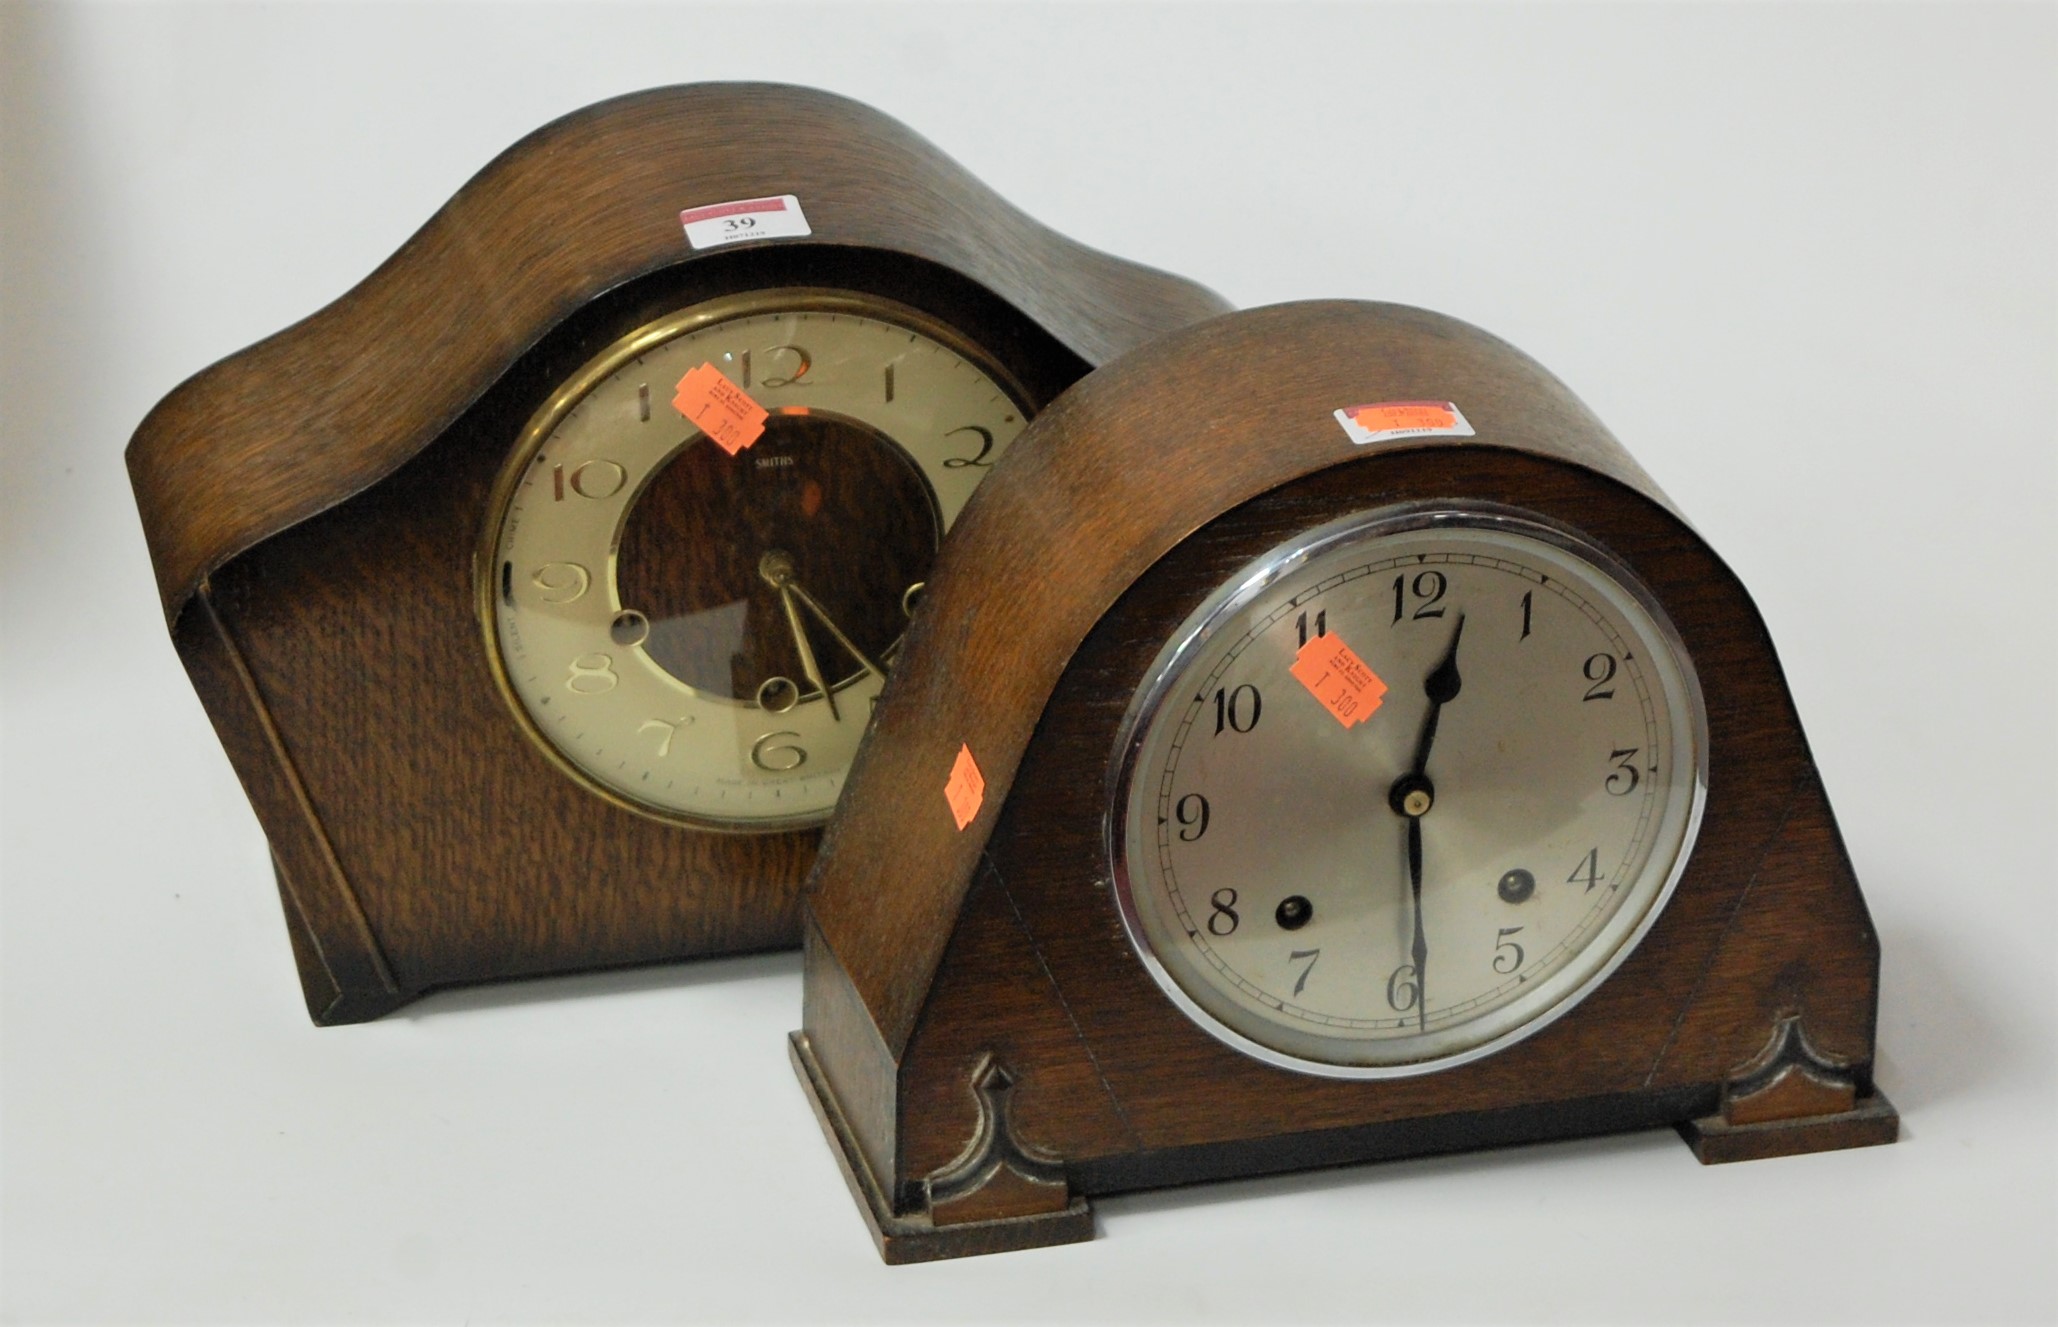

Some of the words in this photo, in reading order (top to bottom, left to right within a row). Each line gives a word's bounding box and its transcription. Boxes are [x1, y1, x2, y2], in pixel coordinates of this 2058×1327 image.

[723, 217, 756, 232] 39
[741, 345, 814, 388] 12
[884, 363, 895, 402] 1
[755, 456, 794, 469] SMITHS
[943, 426, 994, 468] 2
[553, 459, 628, 501] 10
[532, 562, 592, 603] 9
[1391, 571, 1448, 627] 12
[1520, 590, 1533, 641] 1
[565, 652, 618, 694] 8
[1583, 653, 1617, 701] 2
[1213, 684, 1262, 736] 10
[1329, 687, 1360, 718] 300
[637, 714, 695, 756] 7
[750, 731, 808, 772] 6
[1605, 748, 1639, 796] 3
[1176, 794, 1210, 841] 9
[1566, 848, 1605, 894] 4
[1206, 887, 1240, 936] 8
[1492, 927, 1525, 973] 5
[1288, 949, 1321, 997] 7
[1387, 965, 1420, 1012] 6
